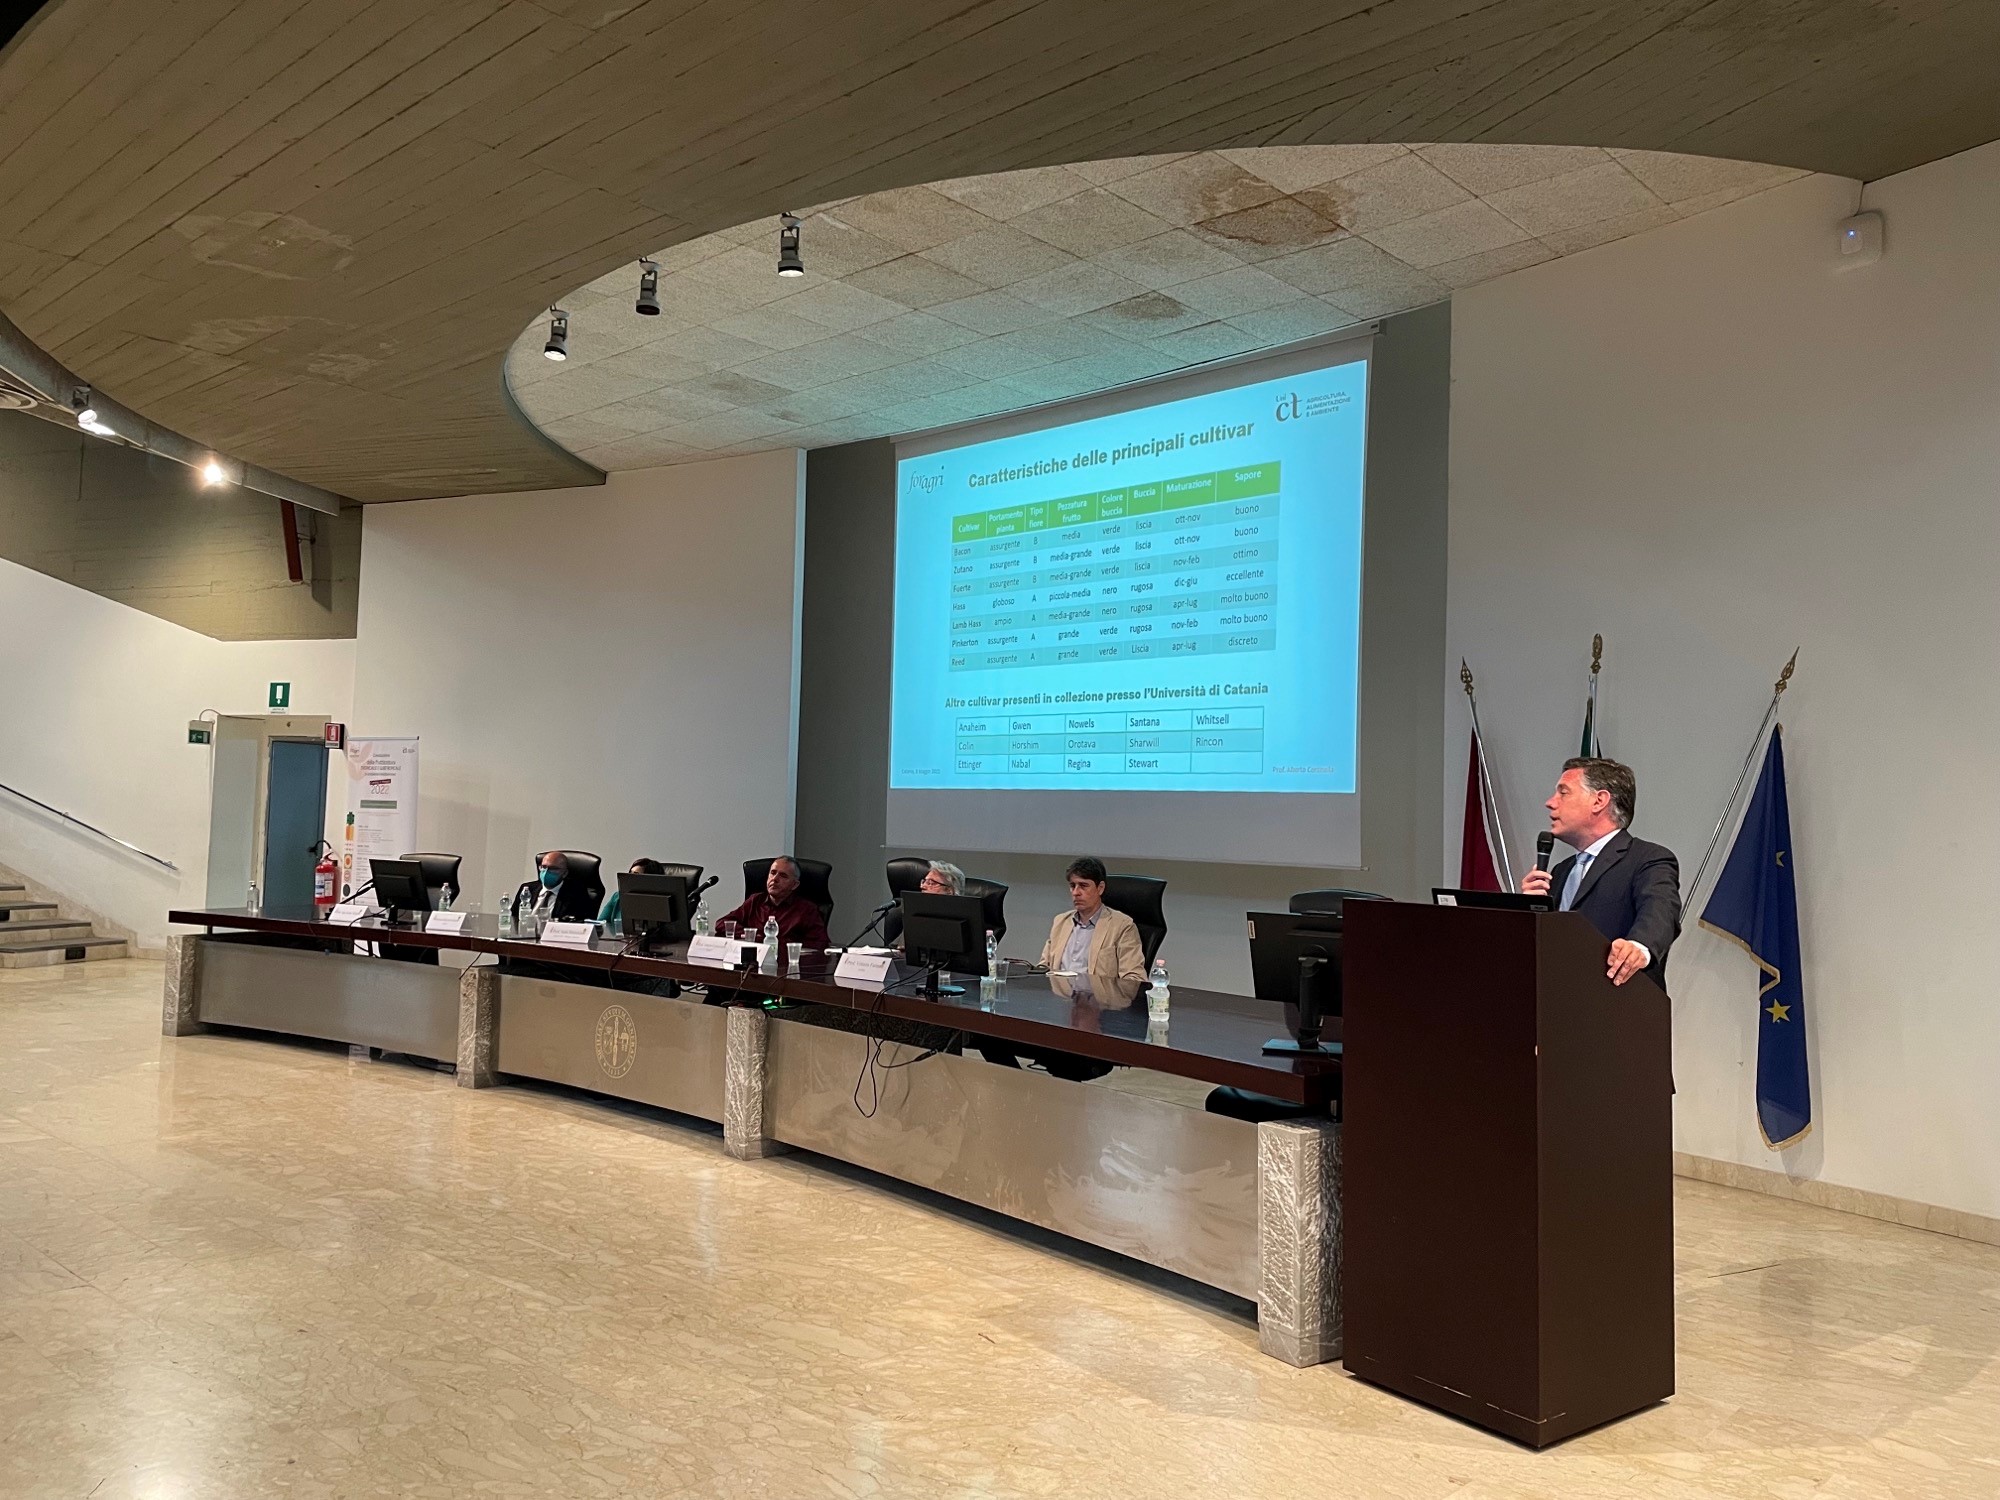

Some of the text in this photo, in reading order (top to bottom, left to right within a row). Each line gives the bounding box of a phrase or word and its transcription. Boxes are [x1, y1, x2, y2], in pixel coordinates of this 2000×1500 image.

[1311, 406, 1340, 417] AMBIENTE
[968, 421, 1255, 488] Caratteristiche delle principali cultivar
[1234, 469, 1262, 483] Sapore
[1166, 478, 1212, 493] Maturazione
[1102, 493, 1123, 504] Colore
[1133, 488, 1156, 499] Buccia
[1057, 499, 1087, 512] Pezzatura
[1235, 504, 1260, 516] buono
[988, 510, 1024, 523] Portamento
[1030, 507, 1044, 517] Tipo
[1101, 507, 1123, 517] buccia
[1062, 513, 1082, 523] frutto
[1175, 514, 1201, 525] ott-nov
[958, 522, 981, 534] Cultivar
[996, 522, 1015, 535] pianta
[1029, 519, 1044, 529] fiore
[1135, 521, 1152, 531] liscia
[1061, 530, 1081, 541] media
[1102, 525, 1121, 536] verde
[1234, 525, 1259, 537] buono
[990, 540, 1021, 552] assurgente
[1033, 536, 1038, 545] B
[1135, 541, 1152, 551] liscia
[1174, 535, 1201, 546] ott-nov
[954, 547, 971, 557] Bacon
[1050, 549, 1092, 562] media-grande
[1101, 545, 1120, 556] verde
[1233, 548, 1259, 560] ottimo
[989, 559, 1020, 570] assurgente
[1033, 556, 1038, 564] B
[1173, 556, 1200, 566] nov-feb
[953, 565, 973, 575] Zutano
[1101, 565, 1120, 575] verde
[1134, 562, 1151, 571] liscia
[1032, 575, 1037, 584] B
[1050, 568, 1092, 581] media-grande
[1226, 569, 1264, 581] eccellente
[989, 579, 1020, 590] assurgente
[1130, 582, 1154, 593] rugosa
[1174, 576, 1198, 588] dic-giu
[953, 584, 971, 593] Fuerte
[1102, 586, 1118, 595] nero
[1031, 594, 1037, 603] A
[1049, 588, 1091, 602] piccola-media
[1220, 591, 1269, 604] molto buono
[952, 603, 966, 611] Hass
[992, 597, 1015, 609] globoso
[1130, 603, 1153, 613] rugosa
[1173, 598, 1198, 609] apr-lug
[1048, 609, 1091, 621] media-grande
[1101, 606, 1117, 615] nero
[994, 617, 1012, 627] ampio
[1031, 614, 1036, 622] A
[1219, 612, 1268, 625] molto buono
[952, 619, 982, 630] Lamb Hass
[1129, 623, 1153, 634] rugosa
[1171, 619, 1199, 630] nov-feb
[1058, 630, 1080, 641] grande
[1099, 625, 1118, 636] verde
[987, 635, 1018, 646] assurgente
[1031, 633, 1036, 641] A
[1228, 636, 1258, 647] discreto
[952, 638, 979, 648] Pinkerton
[1131, 643, 1150, 654] Liscia
[1172, 640, 1197, 651] apr-lug
[1030, 652, 1036, 661] A
[1057, 650, 1079, 660] grande
[1099, 646, 1118, 656] verde
[951, 658, 965, 667] Reed
[986, 654, 1018, 665] assurgente
[945, 682, 1269, 708] Altre cultivar presenti in collezione presso l’Università di Catania
[1068, 718, 1095, 729] Nowels
[1129, 716, 1160, 728] Santana
[1196, 713, 1230, 726] Whitsell
[958, 722, 987, 732] Anaheim
[1012, 721, 1032, 731] Gwen
[958, 741, 974, 750] Colin
[1011, 740, 1039, 750] Horshim
[1068, 739, 1096, 750] Orotava
[1129, 737, 1160, 749] Sharwill
[1195, 737, 1223, 747] Rincon
[958, 760, 982, 771] Ettinger
[1011, 758, 1031, 769] Nabal
[1067, 758, 1091, 771] Regina
[1128, 758, 1159, 769] Stewart
